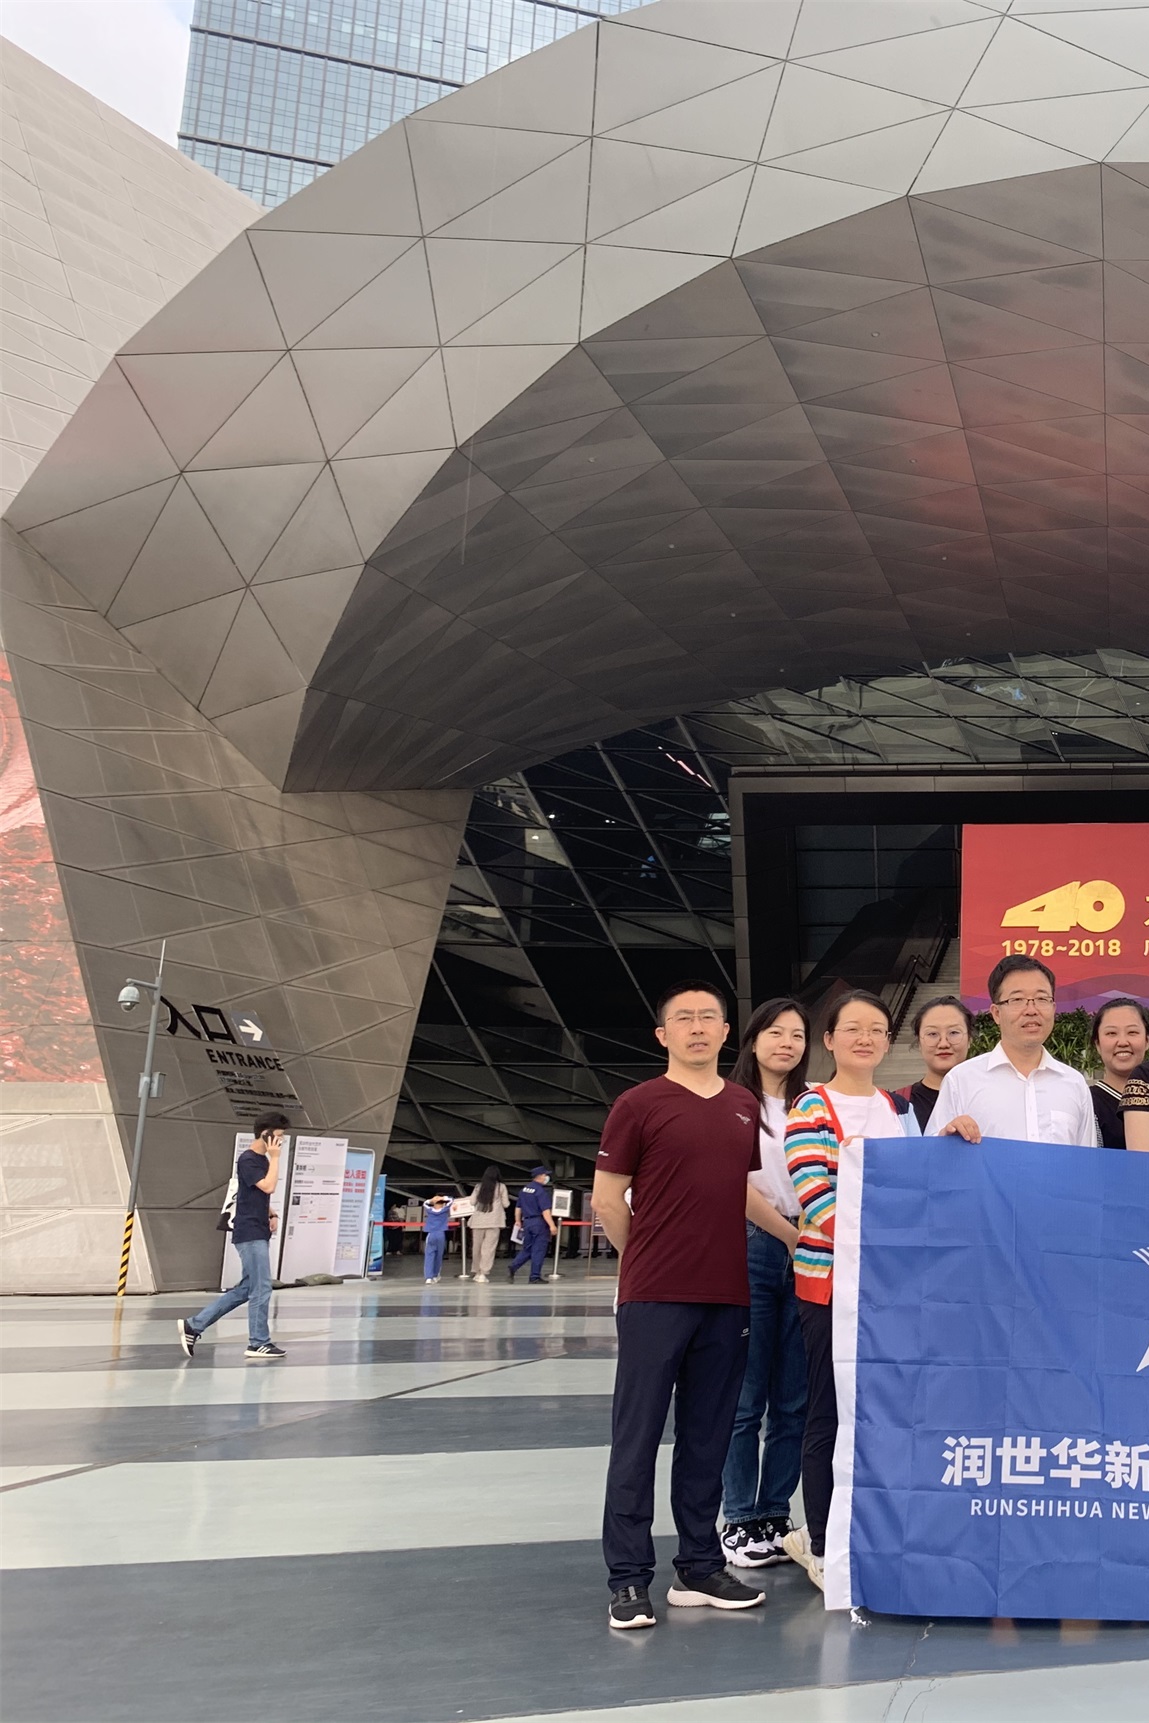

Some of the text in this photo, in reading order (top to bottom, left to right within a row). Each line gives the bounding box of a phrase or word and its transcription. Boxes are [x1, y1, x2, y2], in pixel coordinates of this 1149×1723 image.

[1000, 879, 1126, 933] 40
[1001, 938, 1122, 957] 1978~2018
[159, 995, 238, 1045] 入口
[205, 1048, 285, 1072] ENTRANCE
[970, 1498, 1103, 1519] RUNSHIHUA
